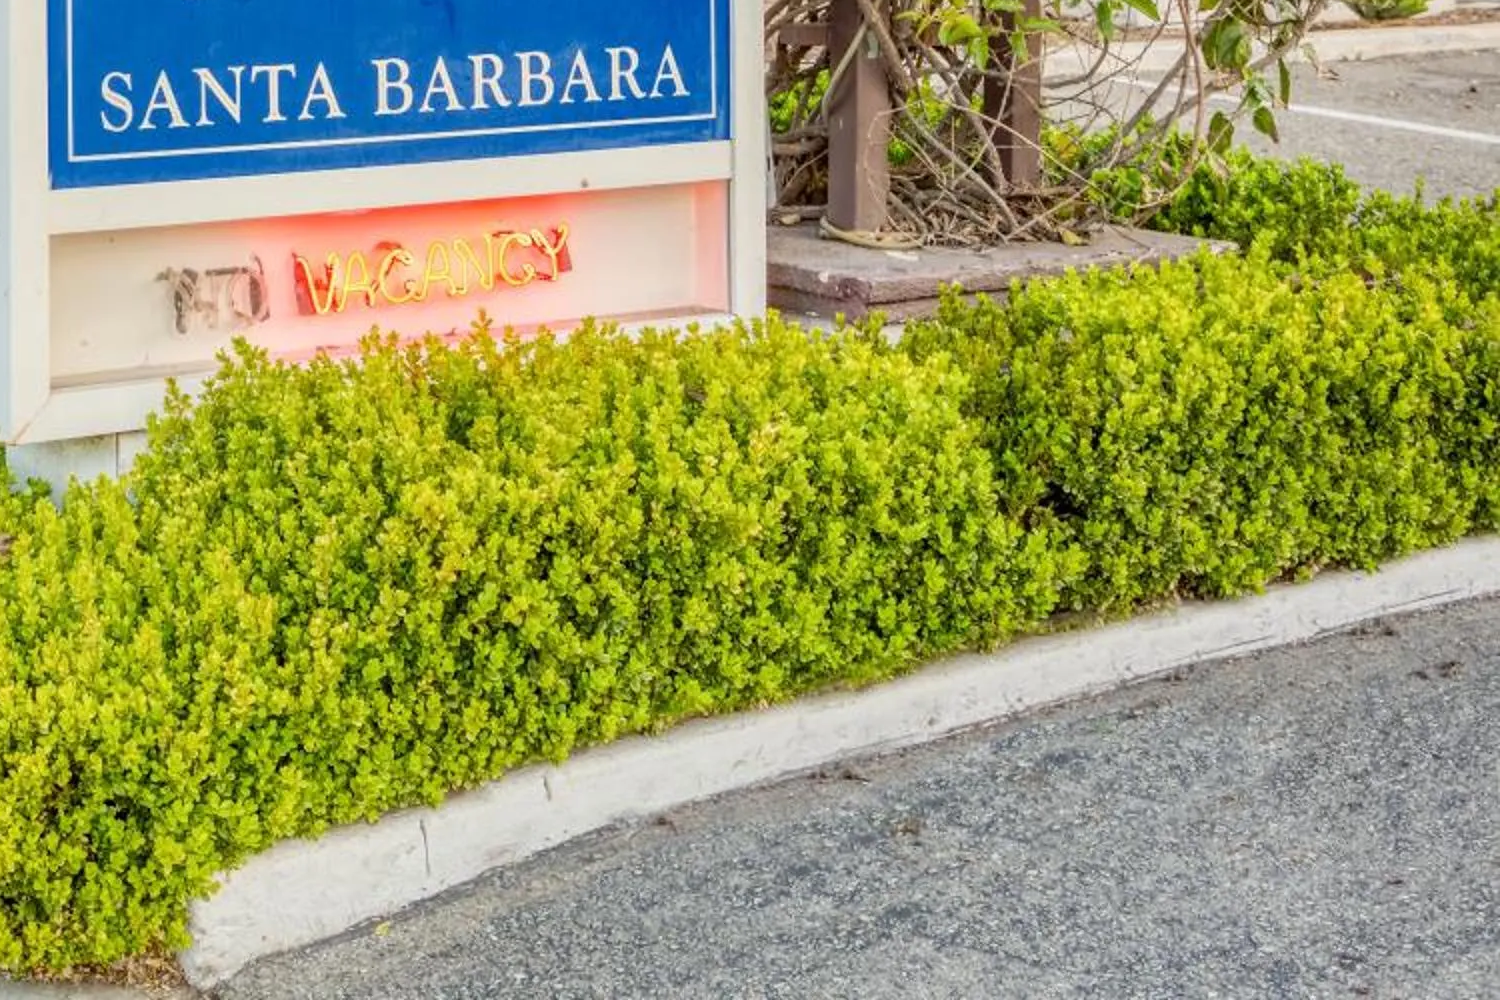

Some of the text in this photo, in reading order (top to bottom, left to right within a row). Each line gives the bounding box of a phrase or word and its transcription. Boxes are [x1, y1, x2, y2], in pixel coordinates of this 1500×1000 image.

[100, 44, 691, 133] SANTA BARBARA
[294, 222, 571, 316] VACANCY
